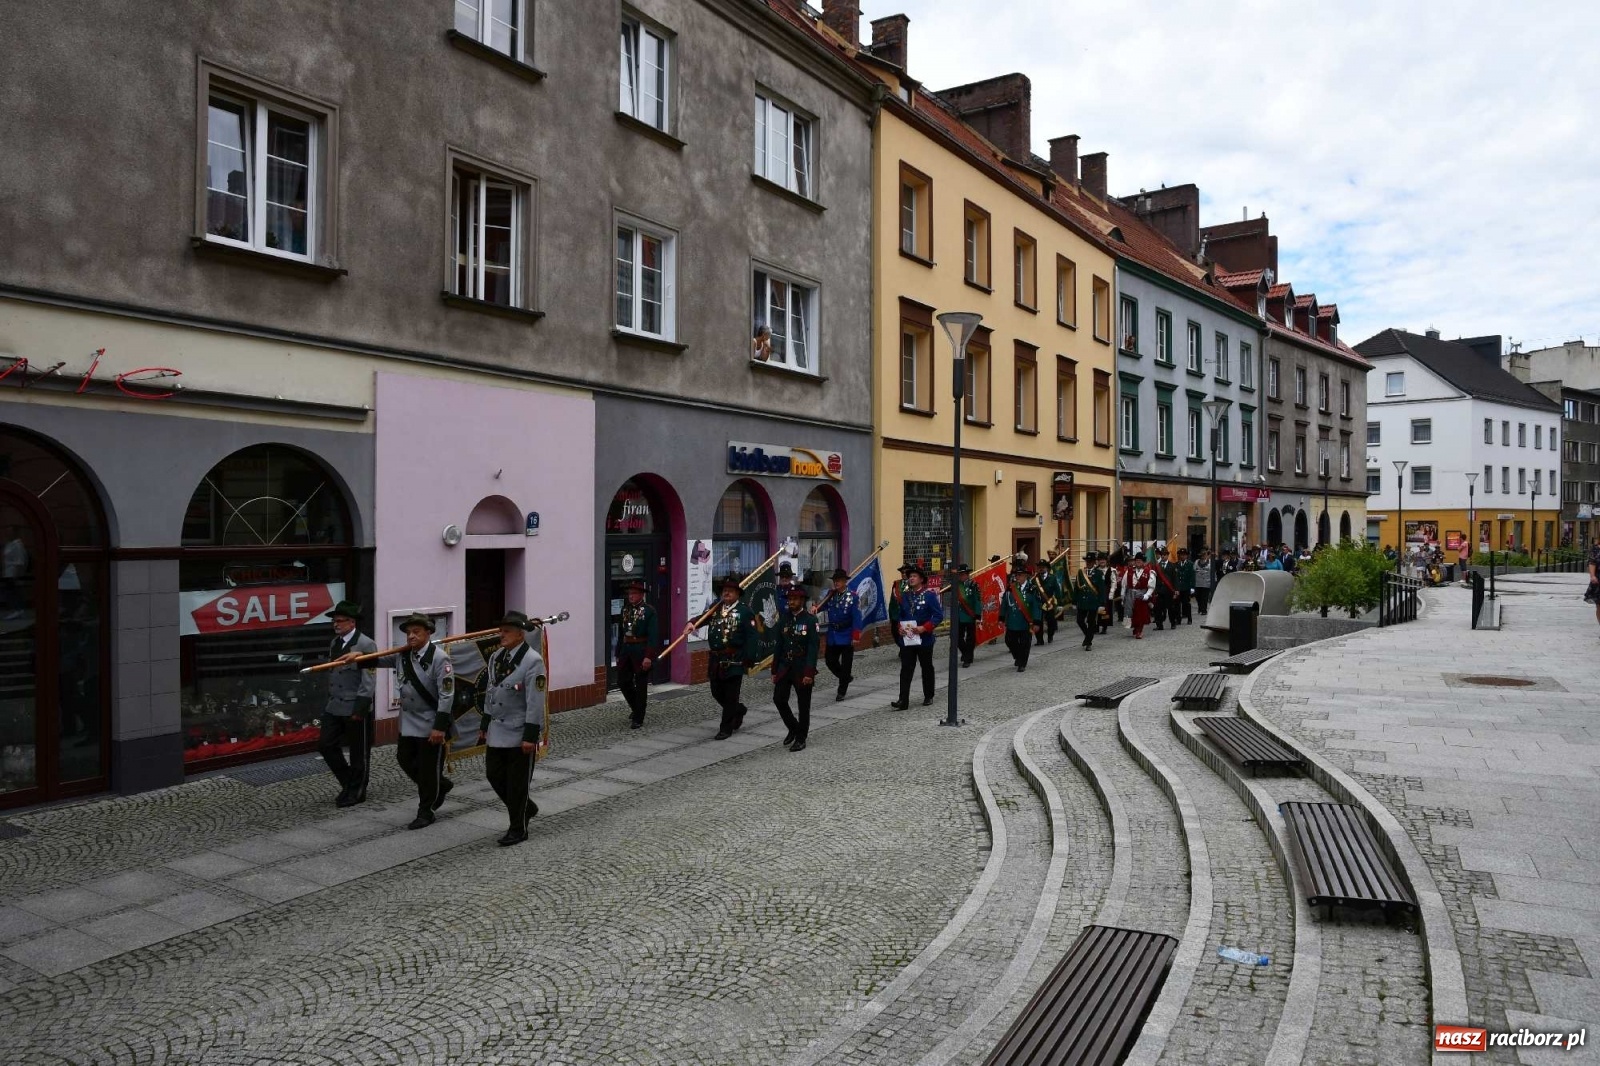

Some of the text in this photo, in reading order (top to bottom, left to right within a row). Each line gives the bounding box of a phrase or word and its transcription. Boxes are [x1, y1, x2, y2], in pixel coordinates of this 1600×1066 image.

[790, 456, 822, 477] home
[530, 515, 538, 525] 16
[618, 499, 650, 521] firan
[216, 592, 310, 626] SALE
